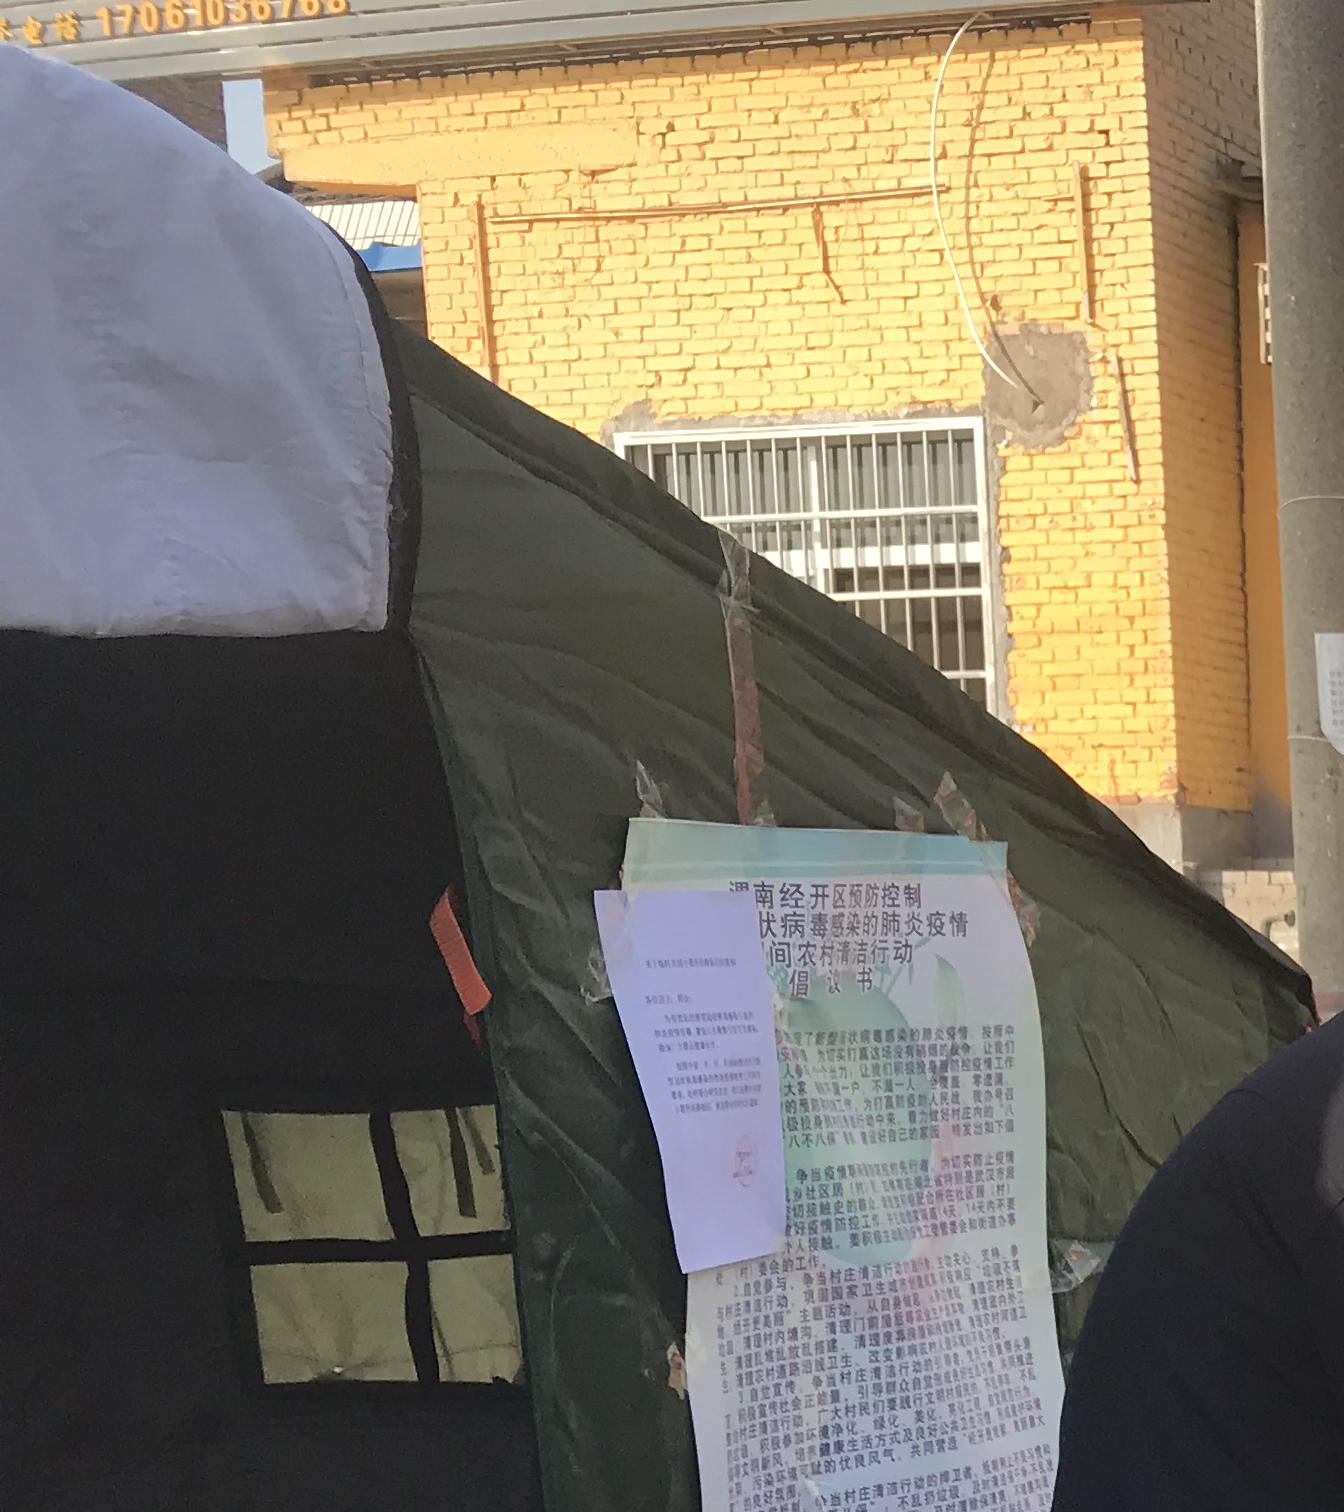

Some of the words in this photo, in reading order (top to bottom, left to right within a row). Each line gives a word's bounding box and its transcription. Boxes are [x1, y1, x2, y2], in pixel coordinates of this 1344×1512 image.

[761, 940, 914, 968] 间农村清洁行动
[788, 968, 874, 998] 倡议书
